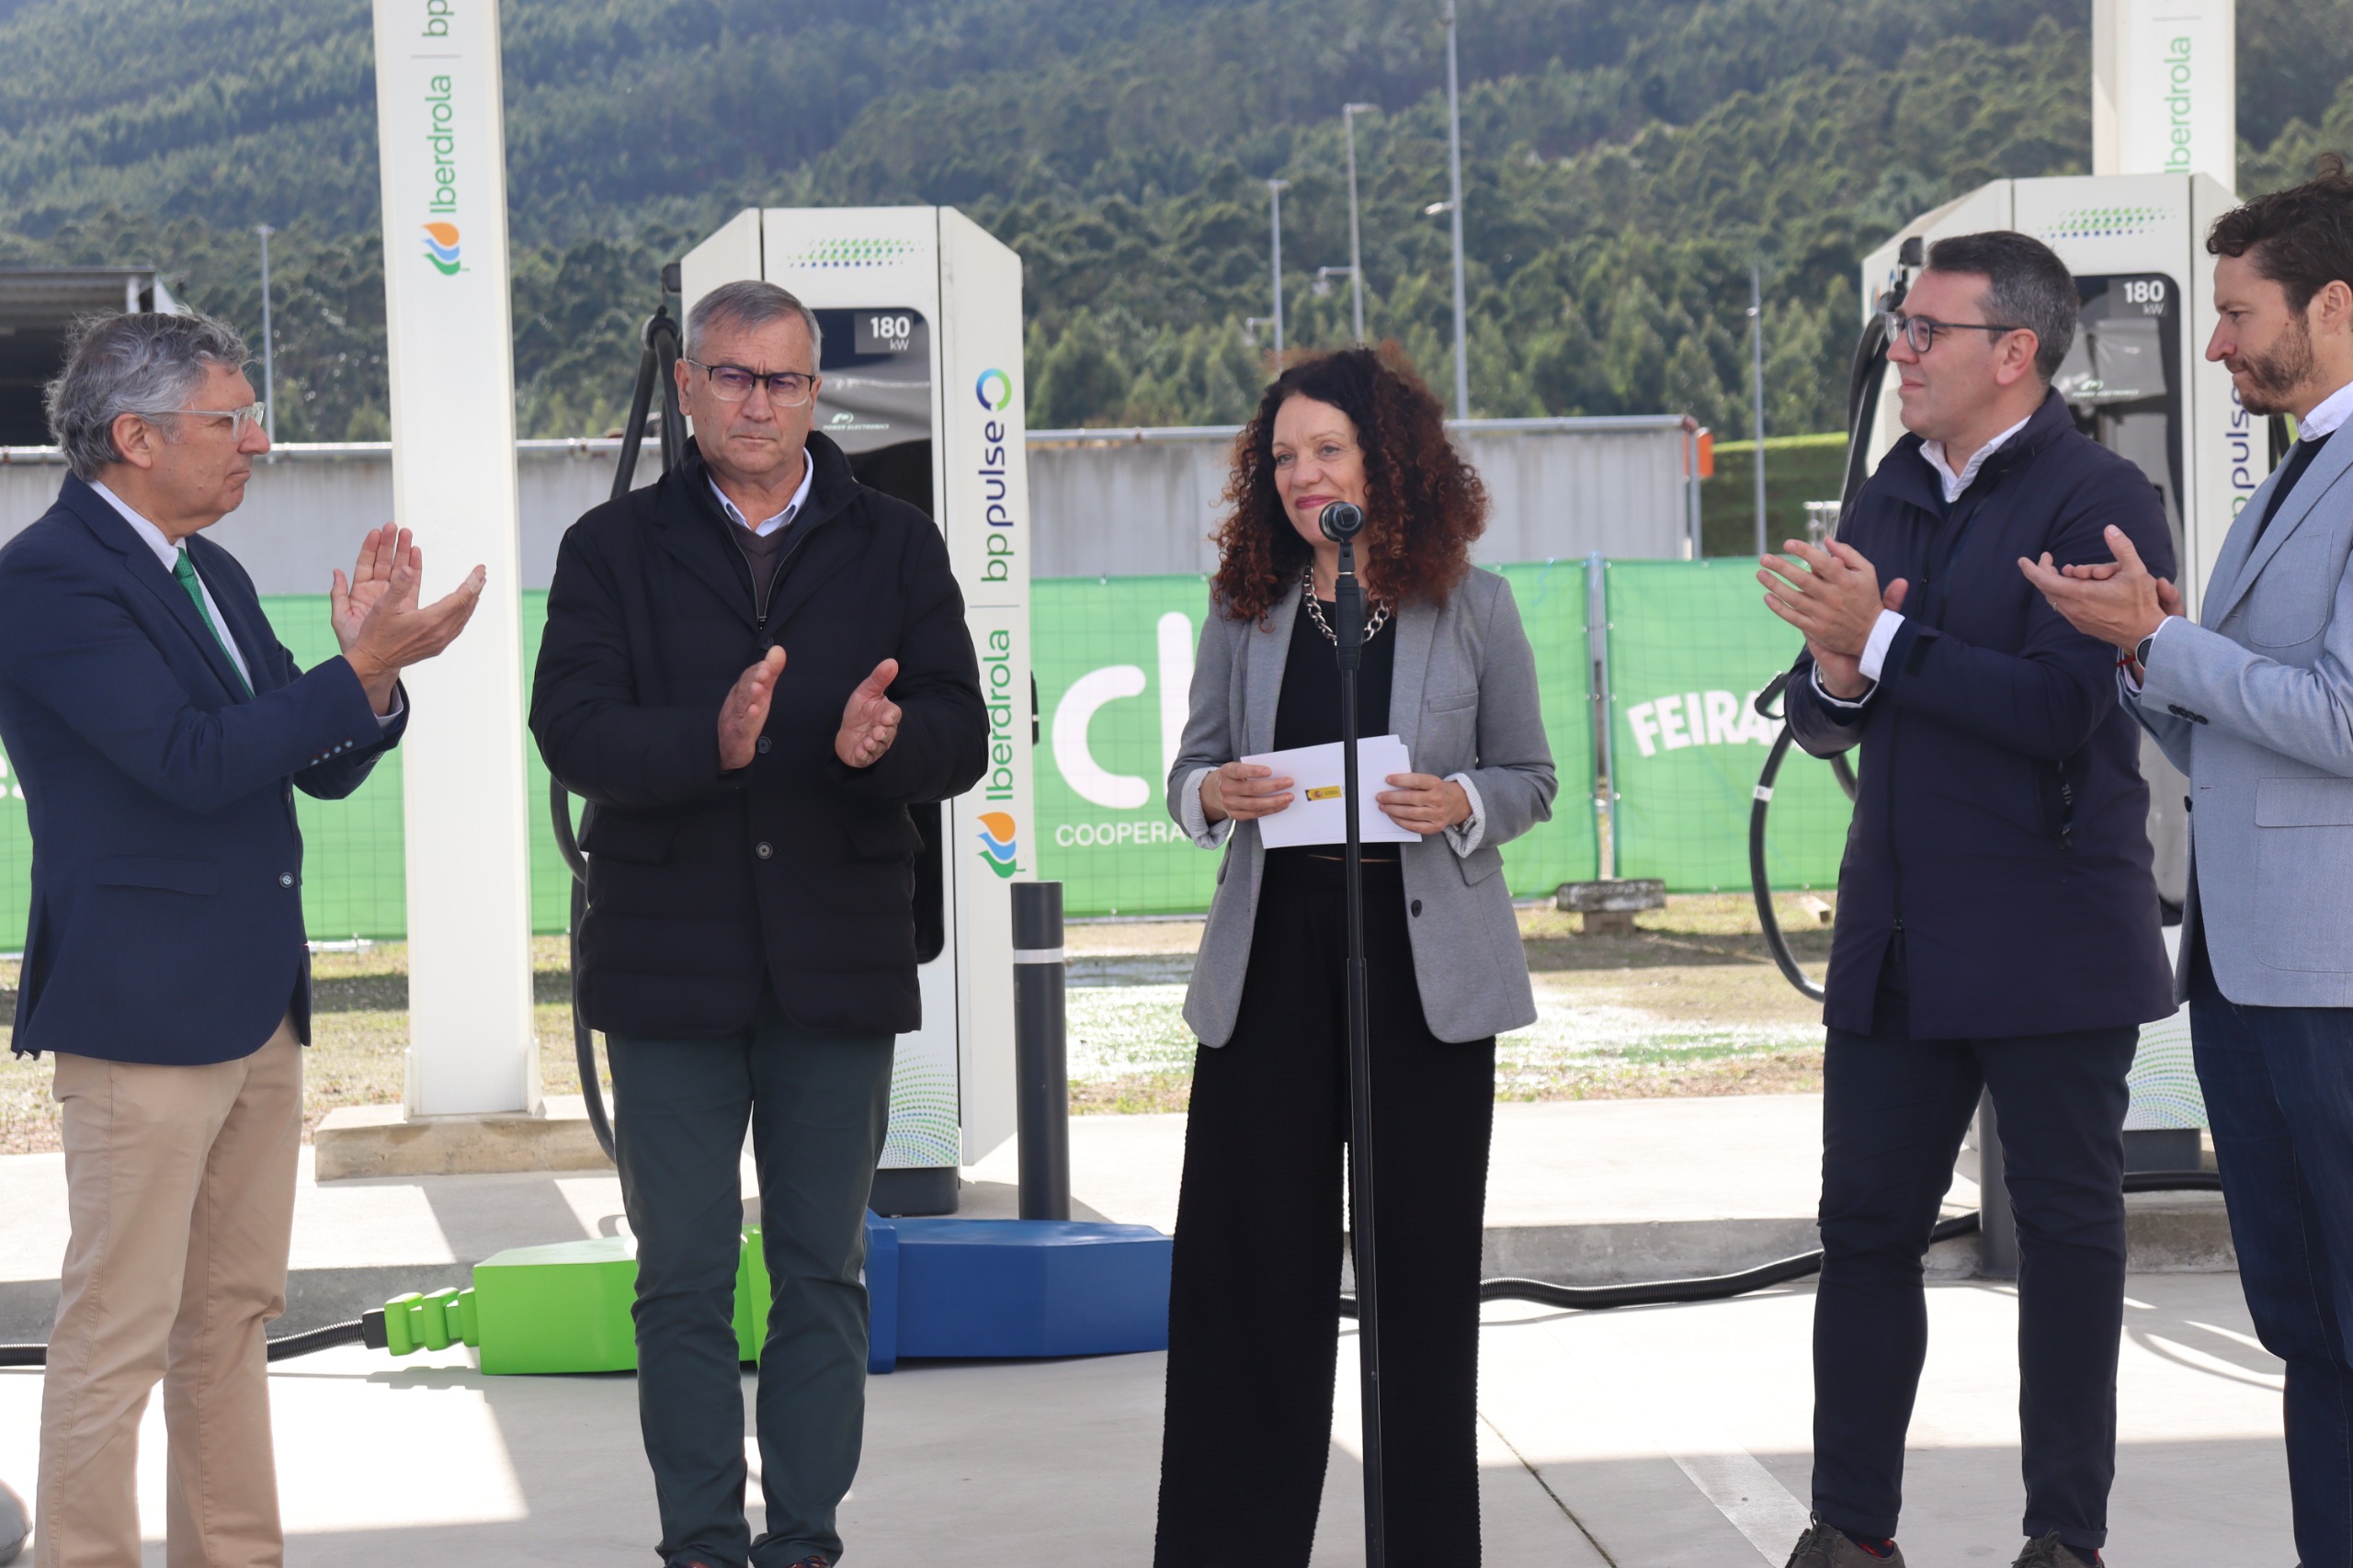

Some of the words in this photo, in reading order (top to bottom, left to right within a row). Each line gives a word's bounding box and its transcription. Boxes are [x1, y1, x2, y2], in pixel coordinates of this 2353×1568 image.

[422, 0, 454, 37] bp
[2164, 37, 2191, 173] Iberdrola
[425, 75, 456, 213] Iberdrola
[2124, 279, 2165, 303] 180
[2143, 303, 2164, 315] kW
[870, 316, 911, 338] 180
[889, 339, 910, 351] kW
[978, 420, 1014, 527] pulse
[981, 533, 1015, 582] bp
[983, 630, 1014, 800] Iberdrola
